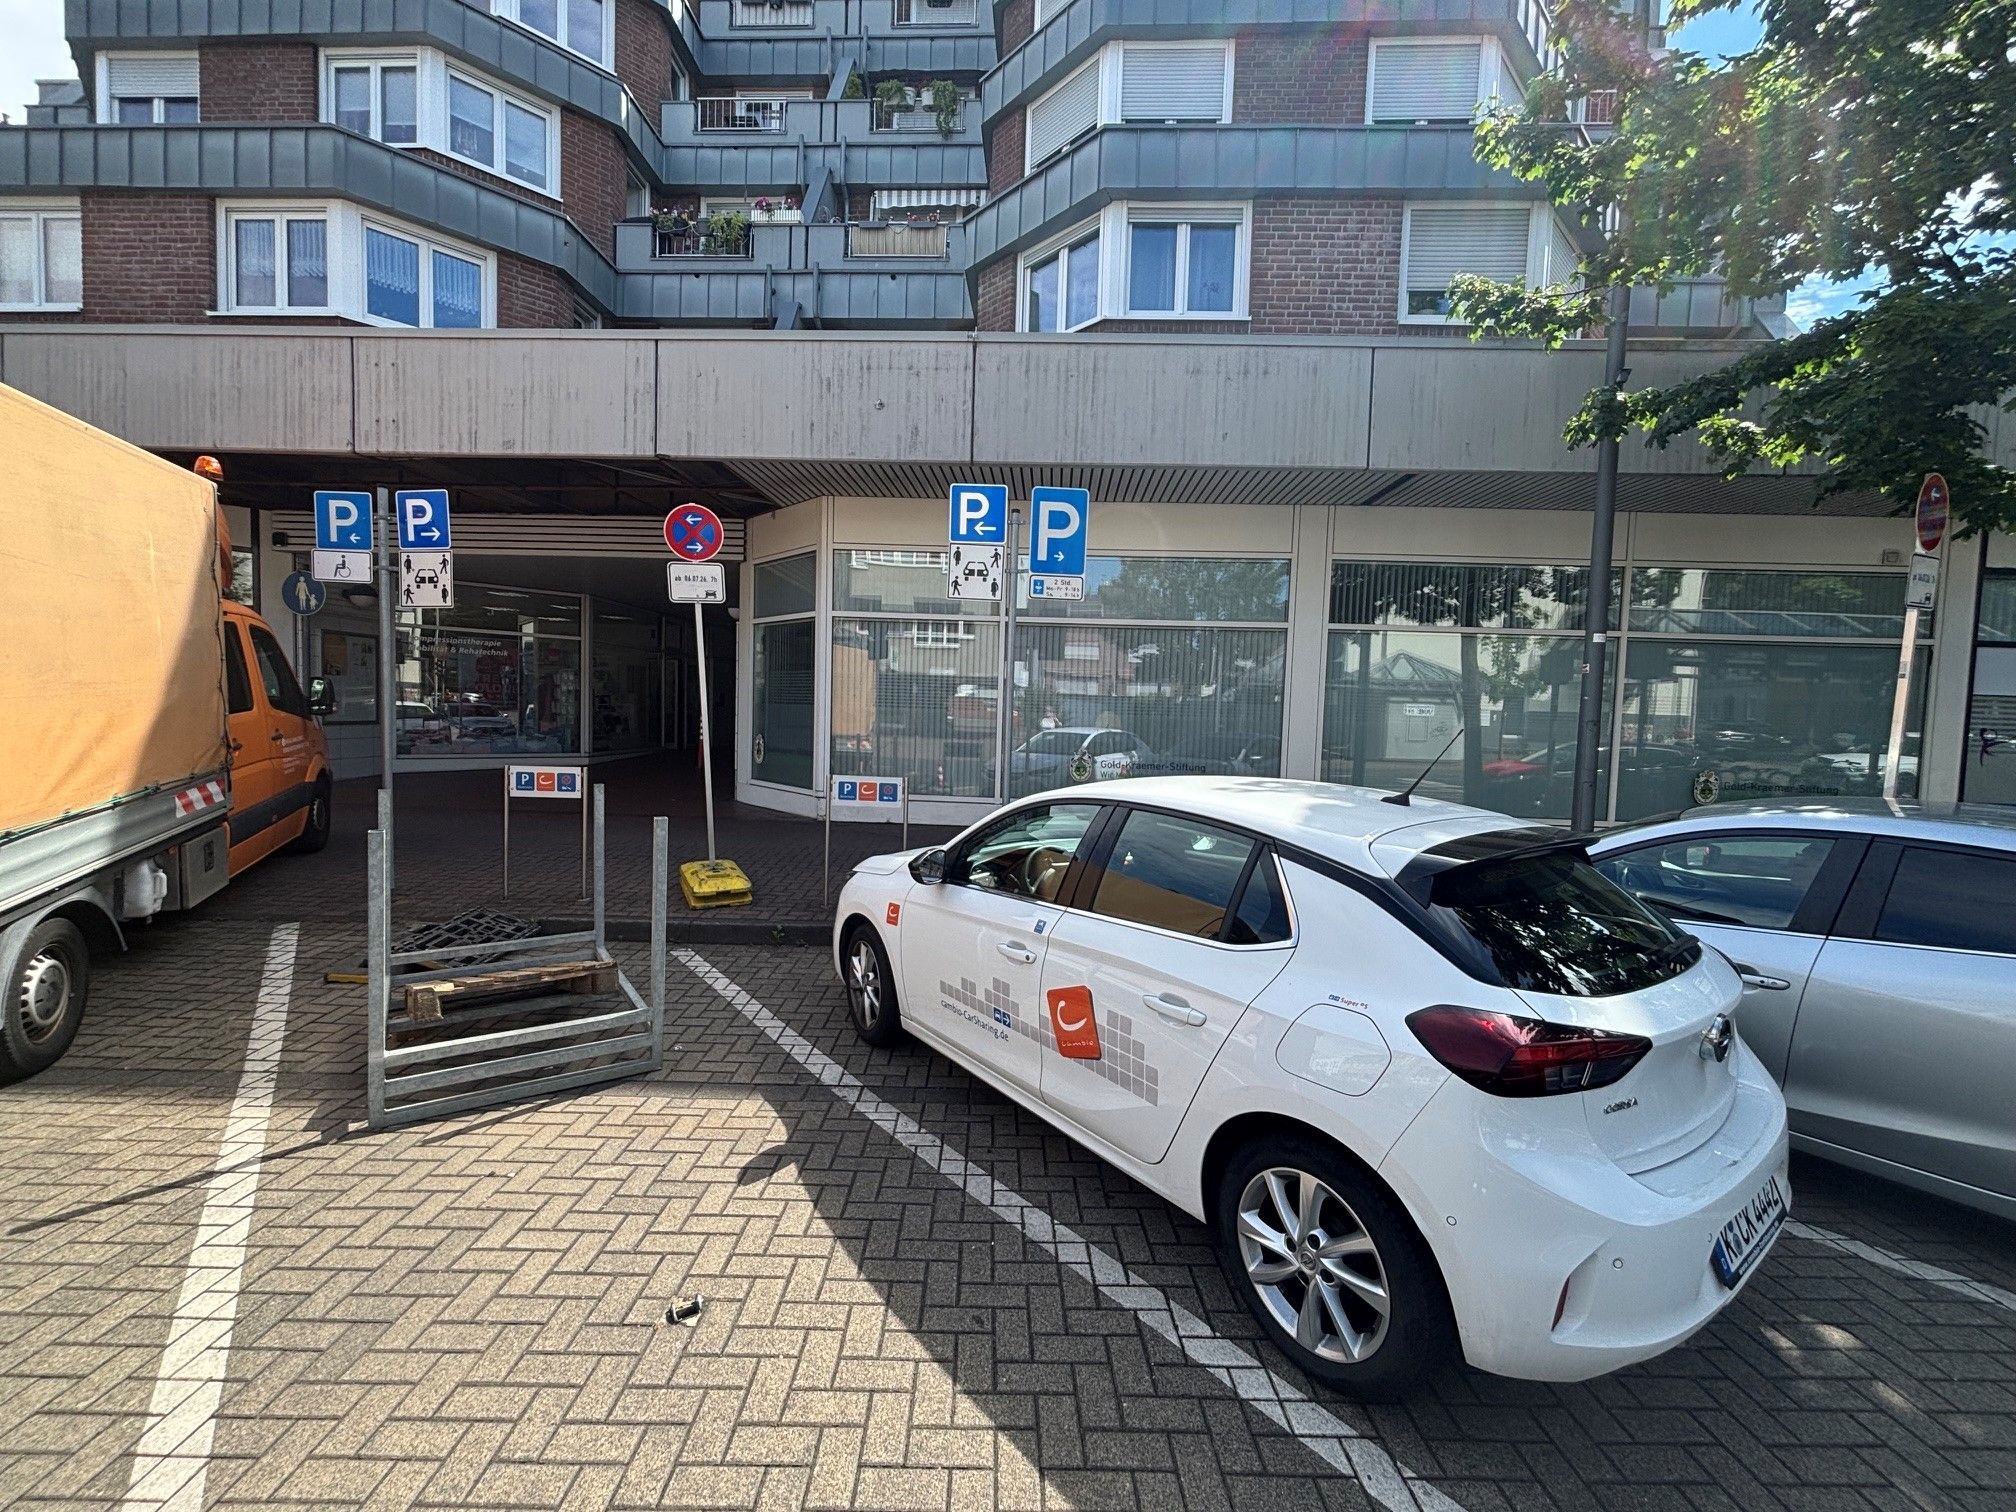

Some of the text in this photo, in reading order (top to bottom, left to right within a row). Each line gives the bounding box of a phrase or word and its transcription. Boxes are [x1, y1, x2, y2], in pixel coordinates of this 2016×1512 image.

[328, 500, 358, 542] P
[405, 499, 433, 542] P
[960, 492, 990, 535] P
[1037, 501, 1080, 561] P
[459, 647, 508, 657] Rehatechnik
[521, 773, 530, 785] P
[1101, 760, 1206, 772] Gold-Kraemer-Stiftung
[844, 783, 852, 795] P
[941, 999, 1009, 1042] cambio-CarSharing.de
[1340, 997, 1359, 1006] Super
[1719, 1224, 1739, 1264] K
[1734, 1205, 1759, 1246] CK
